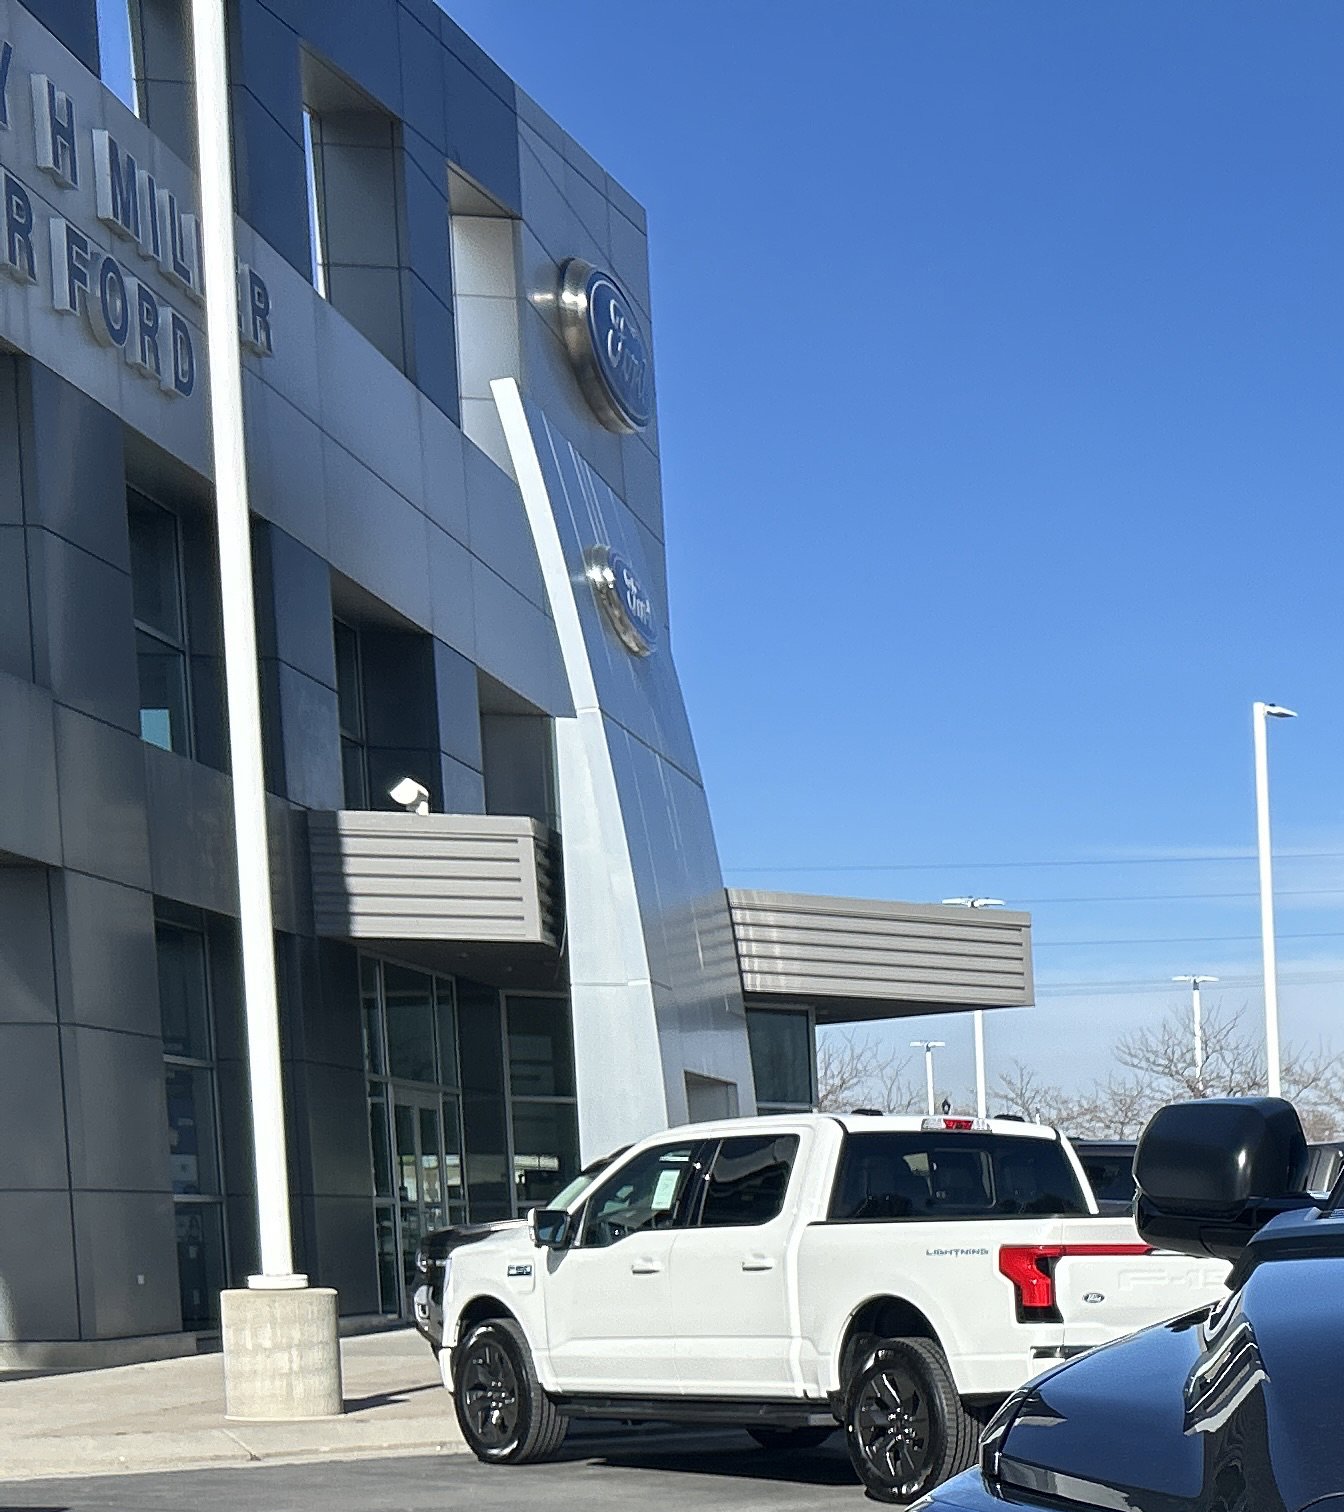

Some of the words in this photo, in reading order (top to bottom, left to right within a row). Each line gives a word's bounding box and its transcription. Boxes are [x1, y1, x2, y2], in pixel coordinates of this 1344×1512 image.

[32, 73, 78, 188] H
[92, 128, 272, 356] MILLR
[50, 217, 197, 398] FORD
